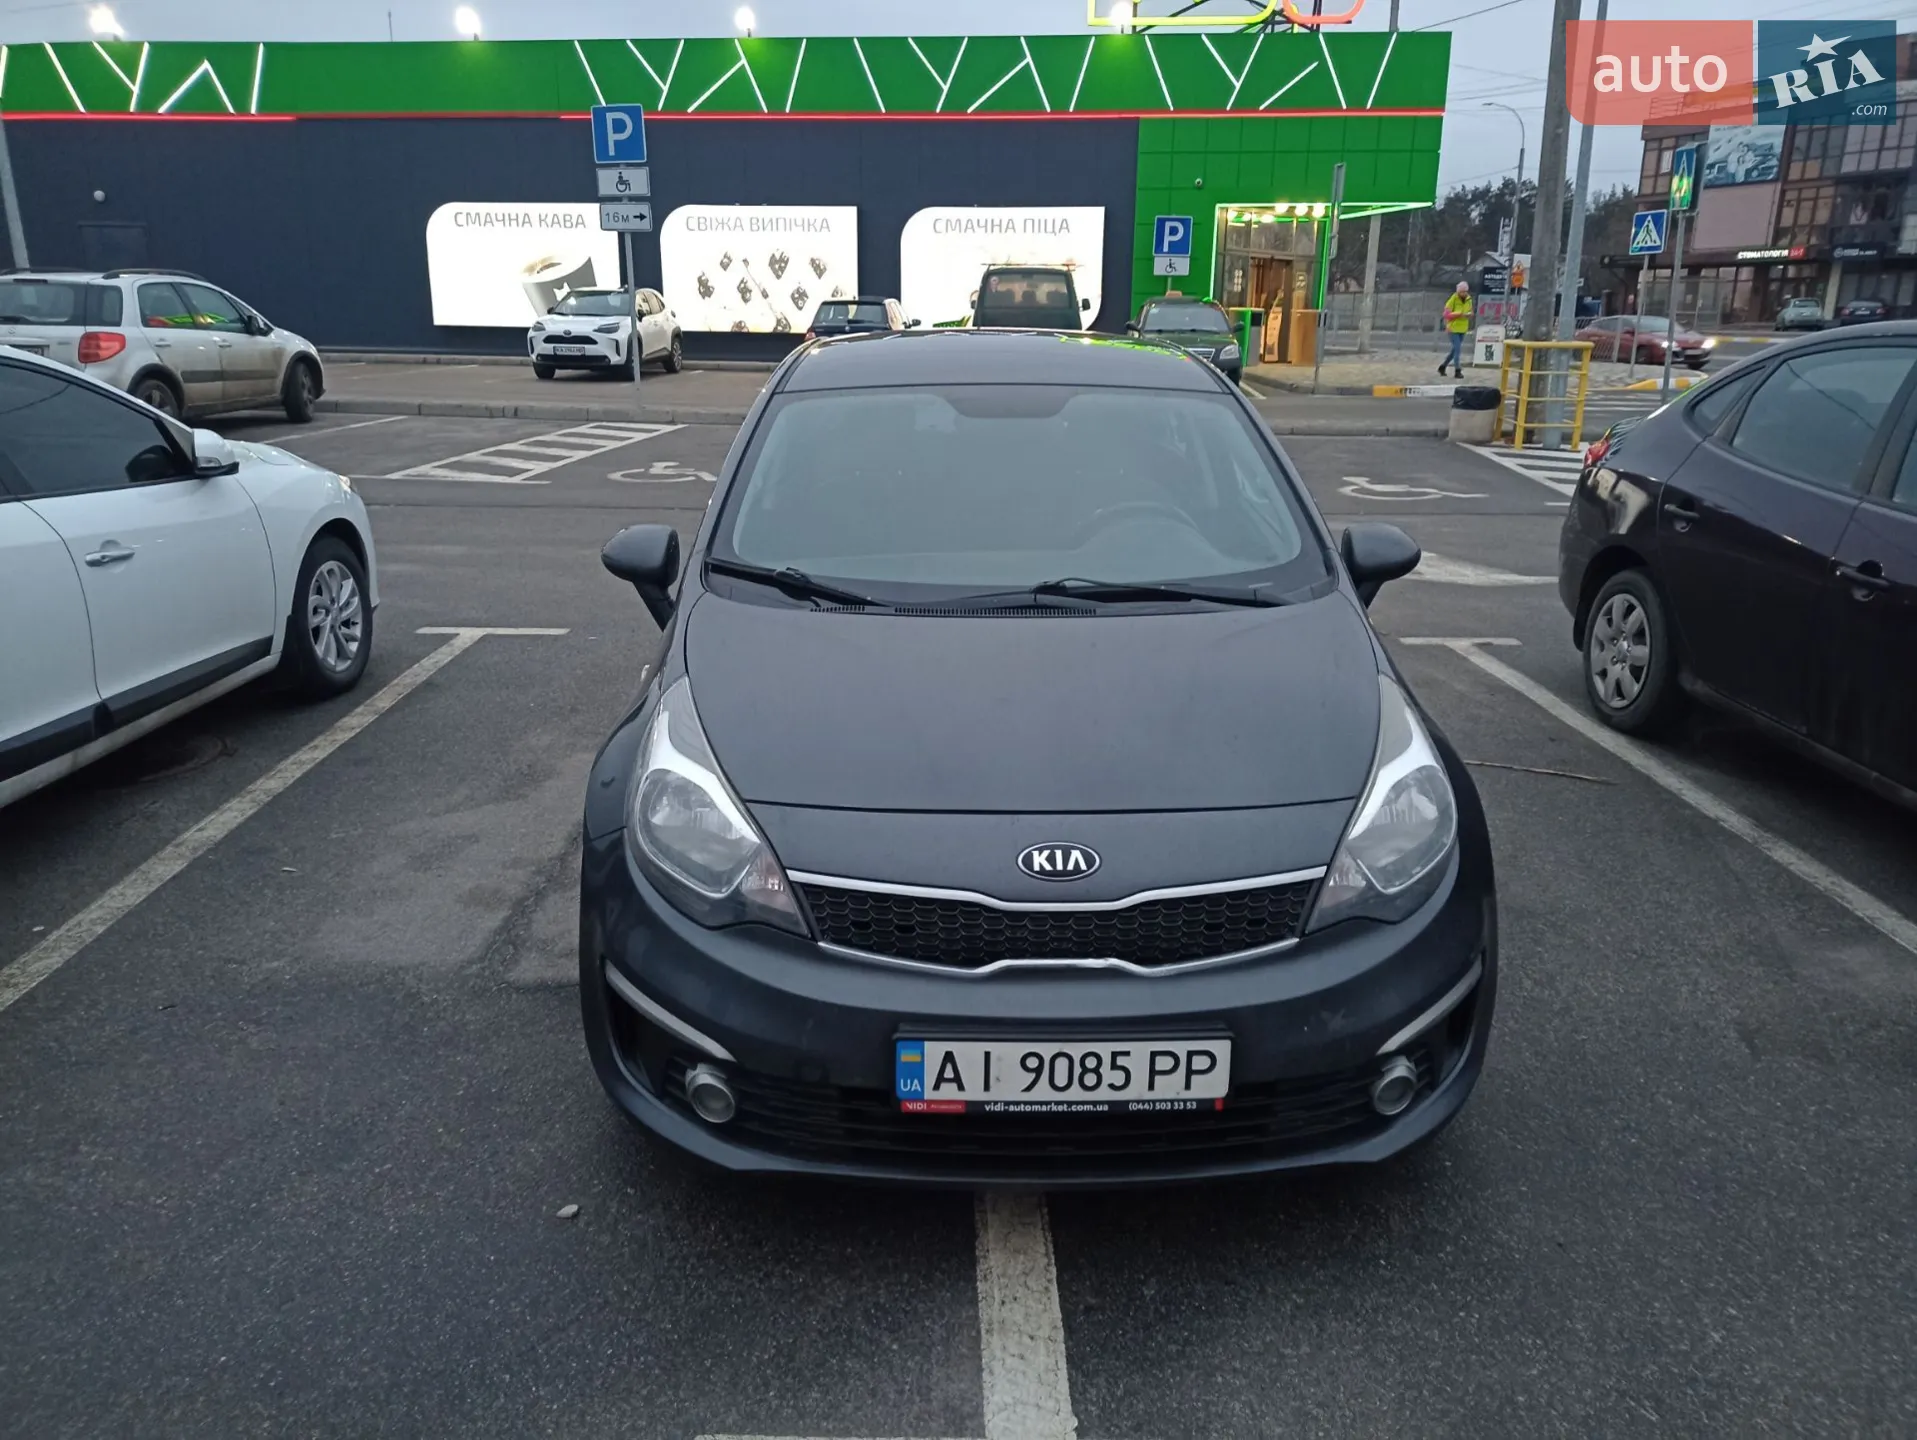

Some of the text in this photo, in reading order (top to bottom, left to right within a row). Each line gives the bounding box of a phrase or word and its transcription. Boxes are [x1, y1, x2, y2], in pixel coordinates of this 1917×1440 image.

[605, 112, 633, 156] P
[454, 212, 587, 229] СМАЧНА КАВА
[685, 215, 831, 232] СВІЖА ВИПІЧКА
[933, 218, 1070, 236] СМАЧНА ПІЦА
[1162, 220, 1184, 252] P
[1031, 848, 1088, 872] KIA
[932, 1050, 1218, 1093] AI 9085 PP
[900, 1078, 921, 1092] UA
[984, 1101, 1197, 1112] vidi-automarket.com.ua (044) 503 33 53
